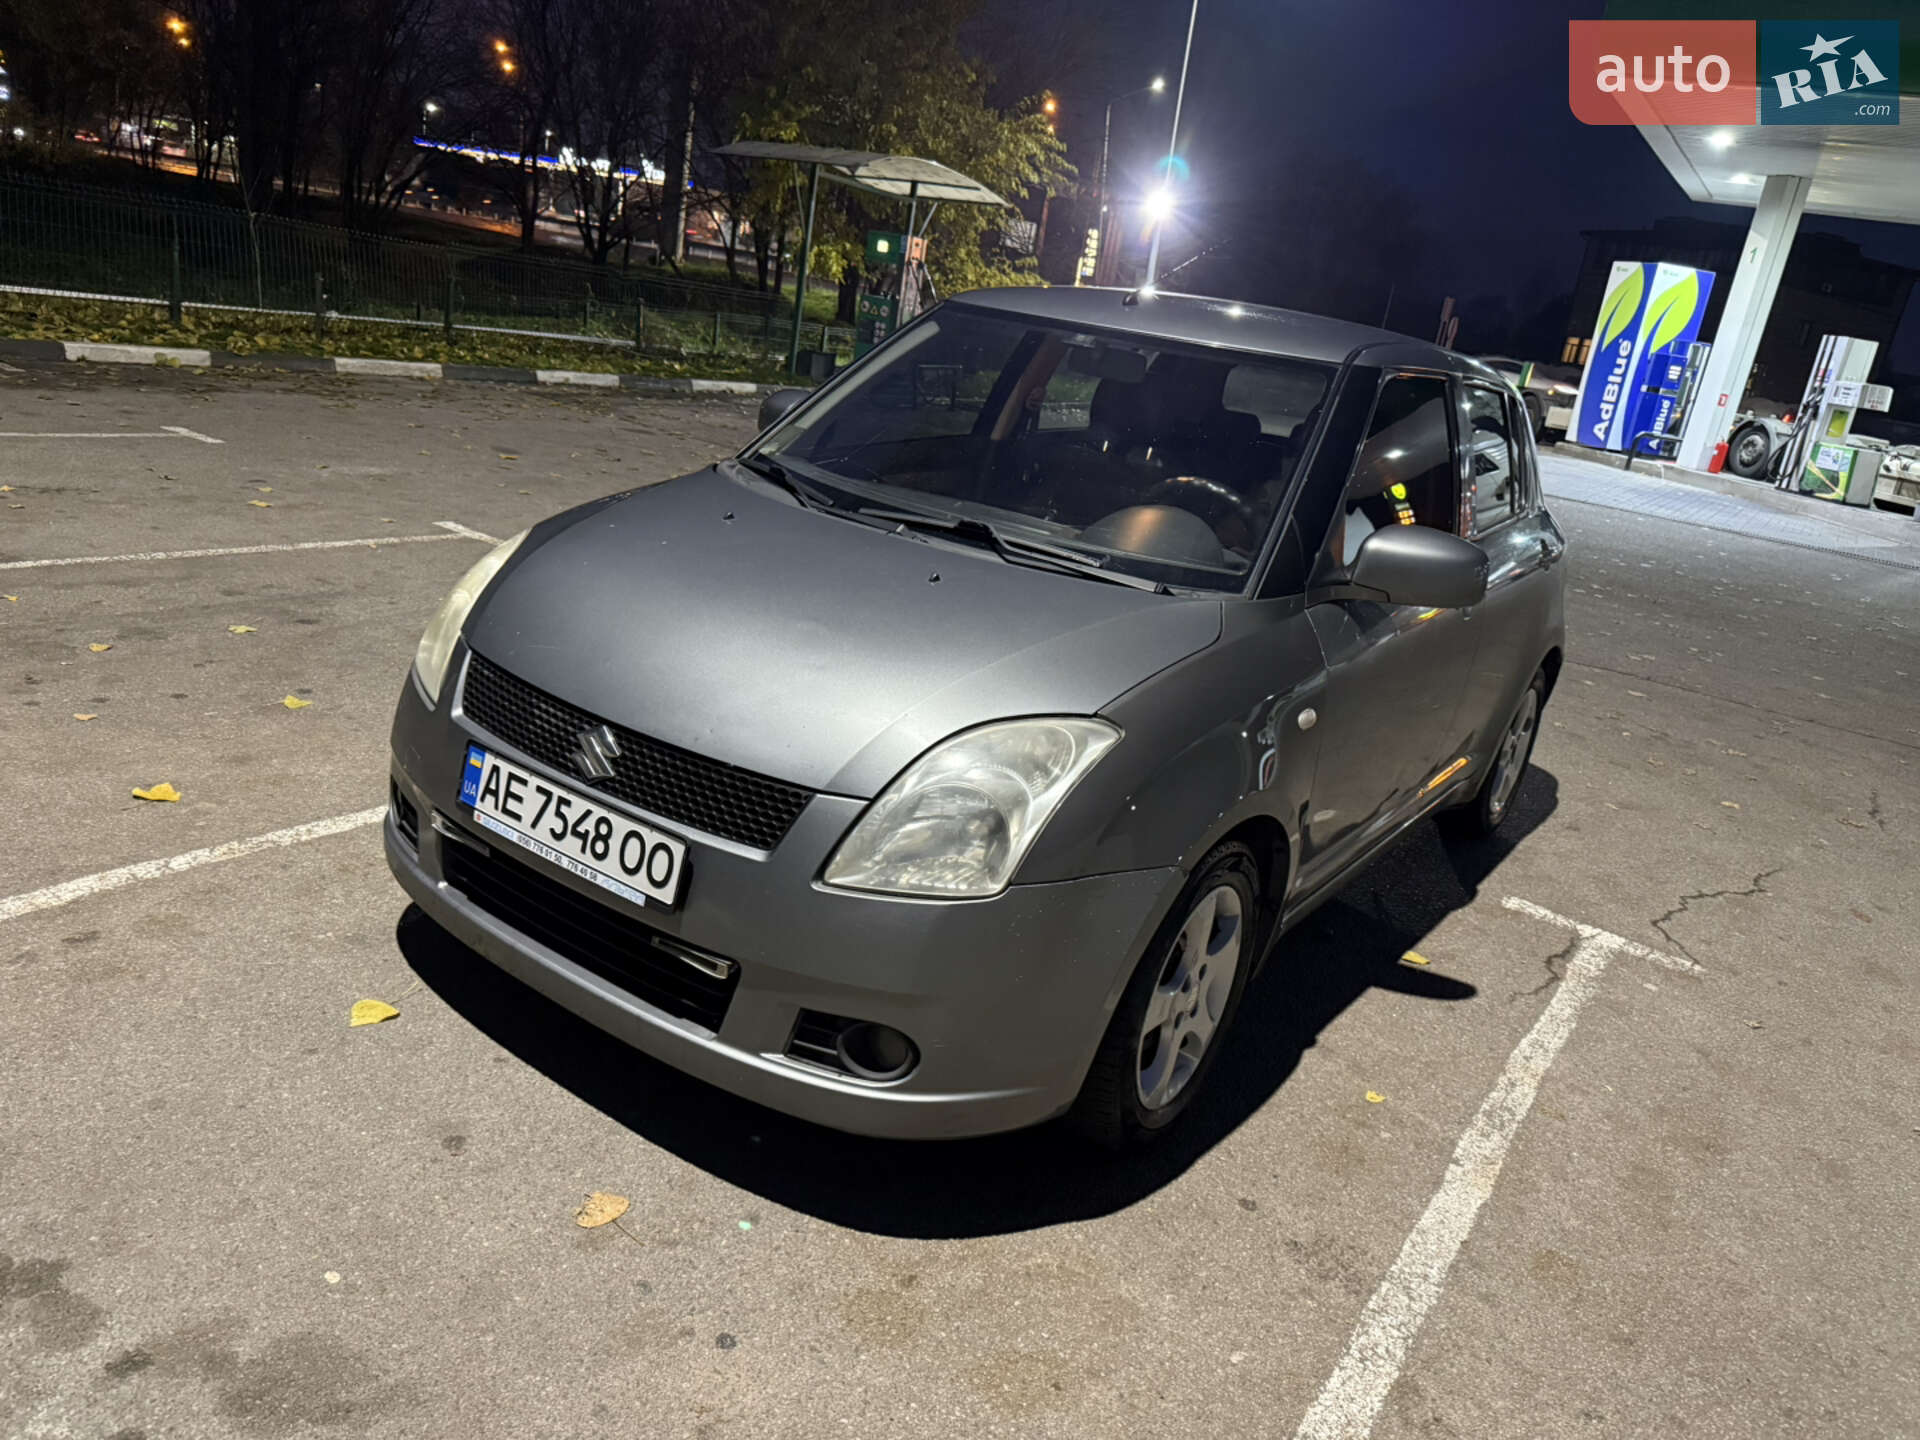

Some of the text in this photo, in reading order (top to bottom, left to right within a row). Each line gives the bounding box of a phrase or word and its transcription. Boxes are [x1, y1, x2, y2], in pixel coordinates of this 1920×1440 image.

[1593, 339, 1632, 441] AdBlue
[464, 780, 476, 797] UA
[480, 763, 529, 823] AE
[530, 785, 613, 861] 7548
